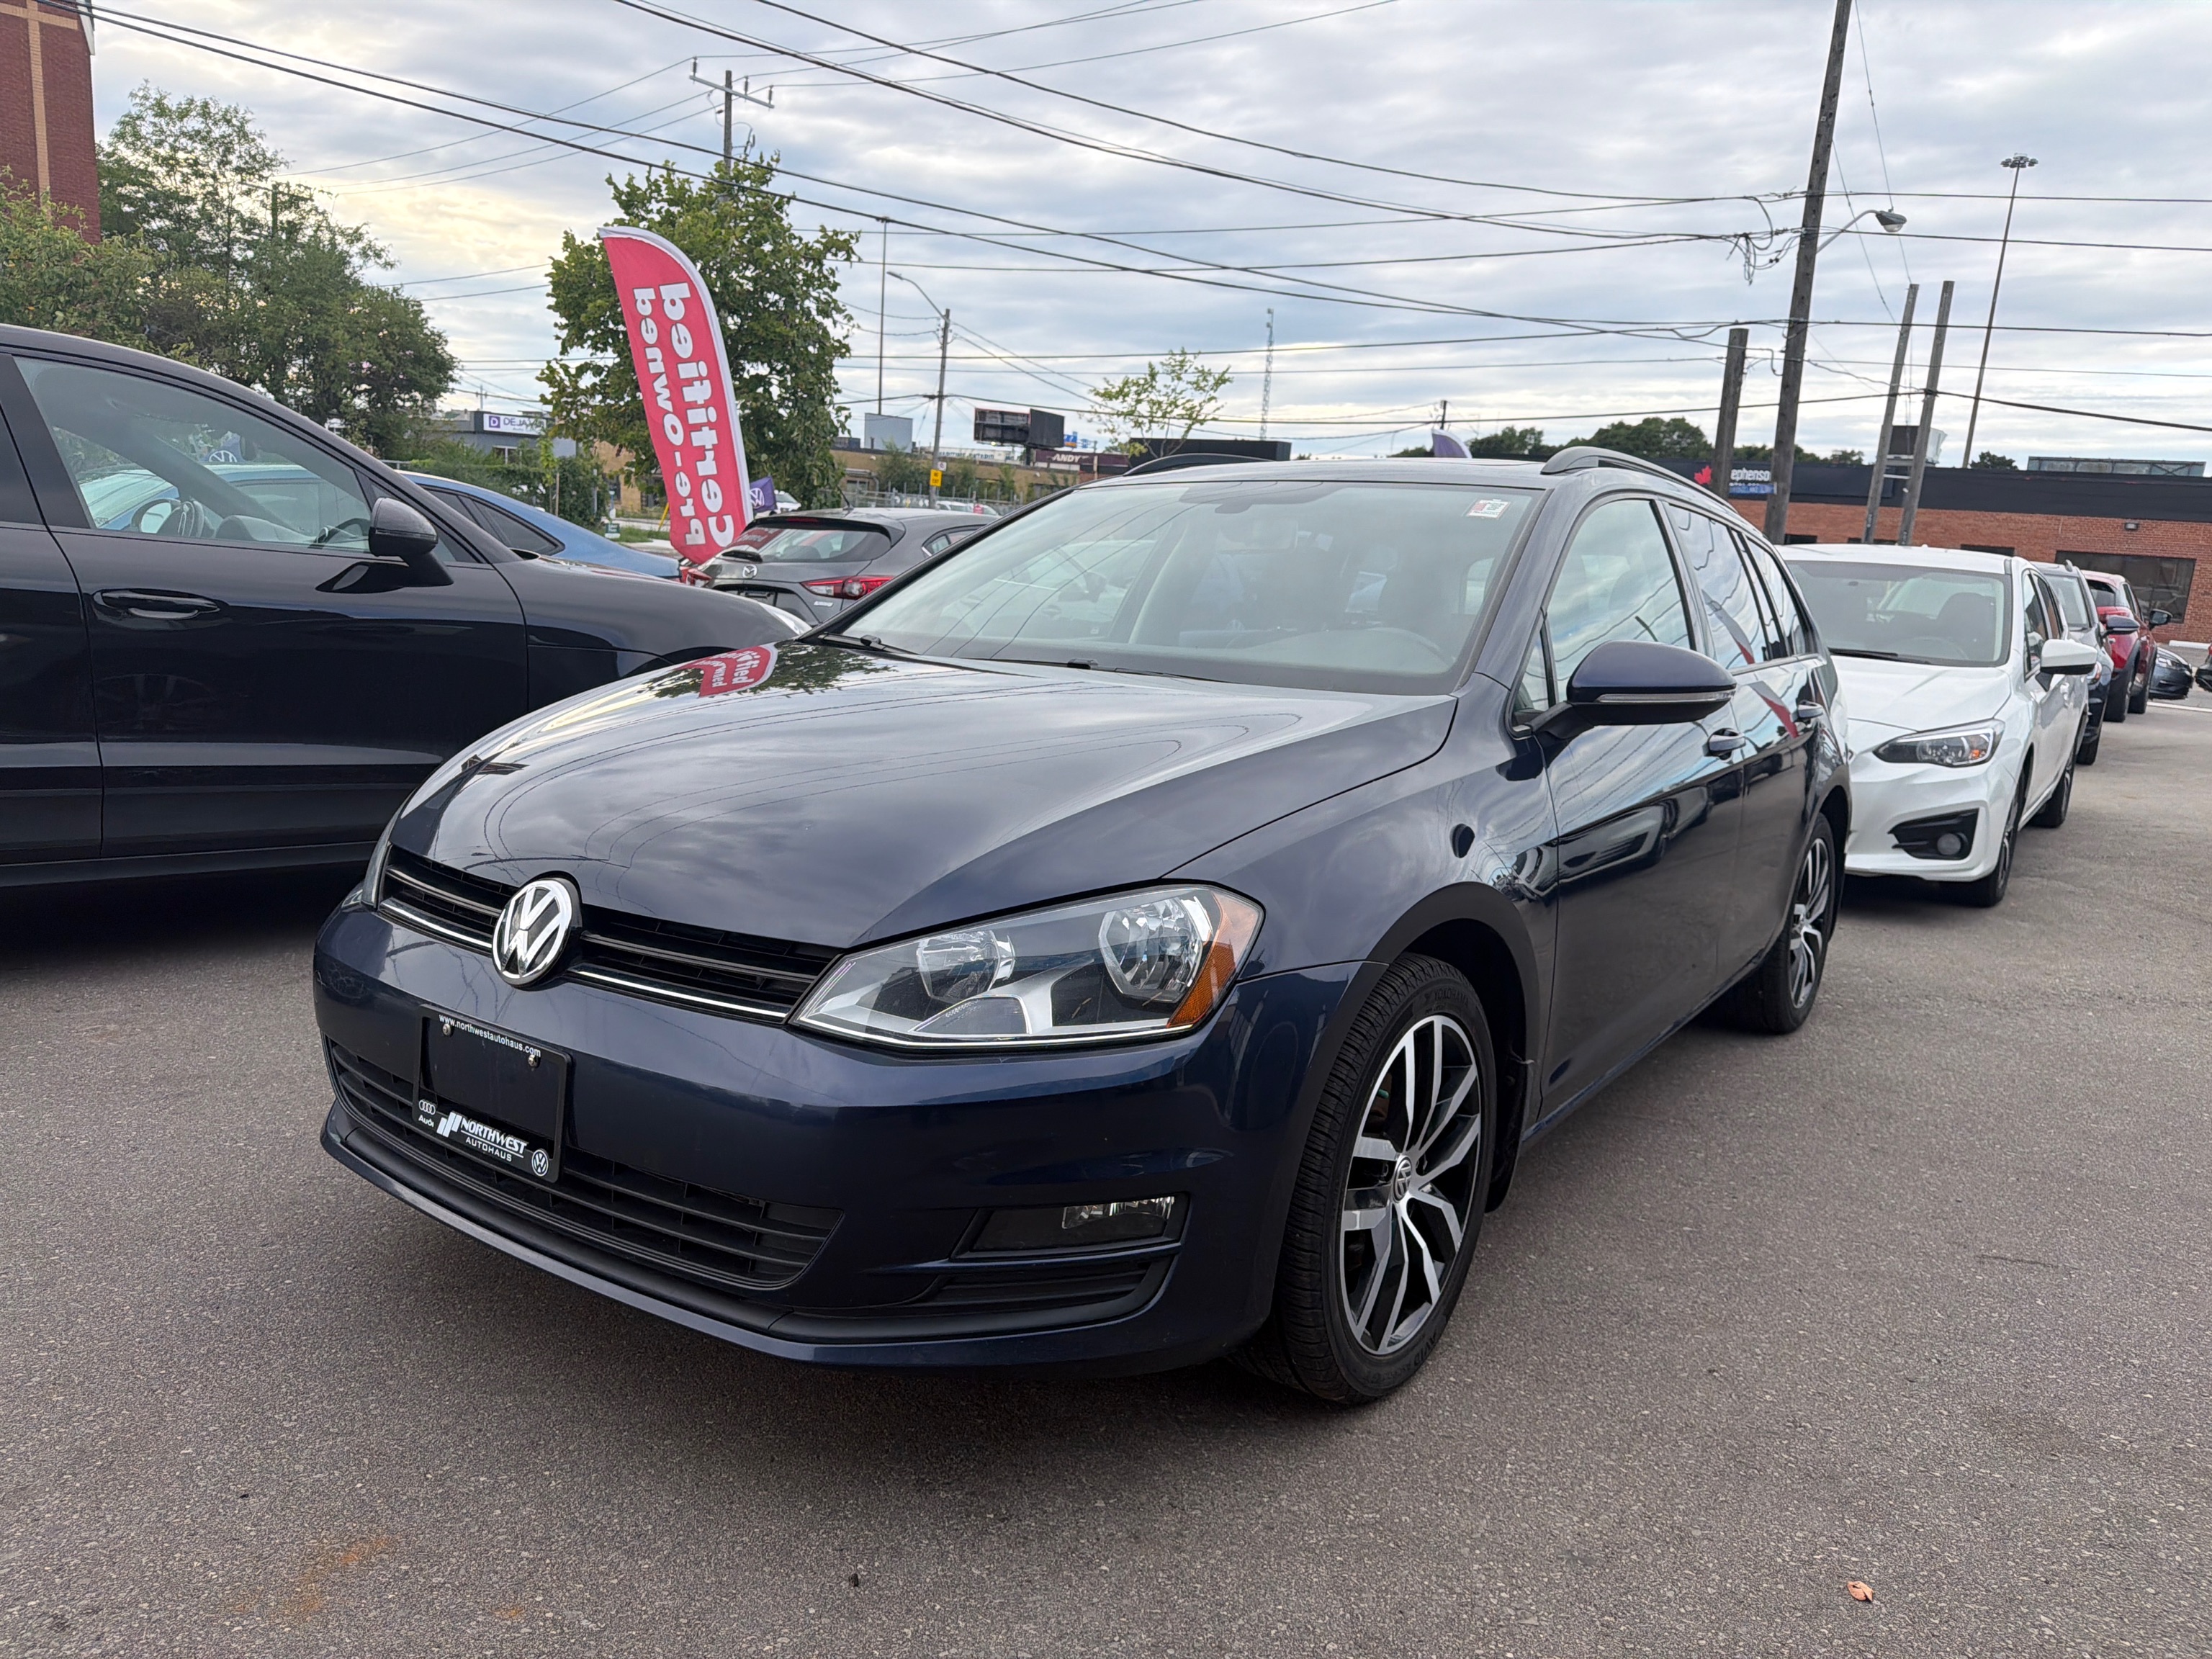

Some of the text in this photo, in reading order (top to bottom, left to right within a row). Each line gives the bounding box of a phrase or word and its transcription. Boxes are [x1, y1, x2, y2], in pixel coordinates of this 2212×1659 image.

[1730, 467, 1771, 482] ephenso
[439, 1014, 541, 1057] www.northwestautohaus.com
[418, 1114, 434, 1128] Audi
[461, 1118, 527, 1154] NORTHWEST
[465, 1136, 512, 1162] AUTOHAUS
